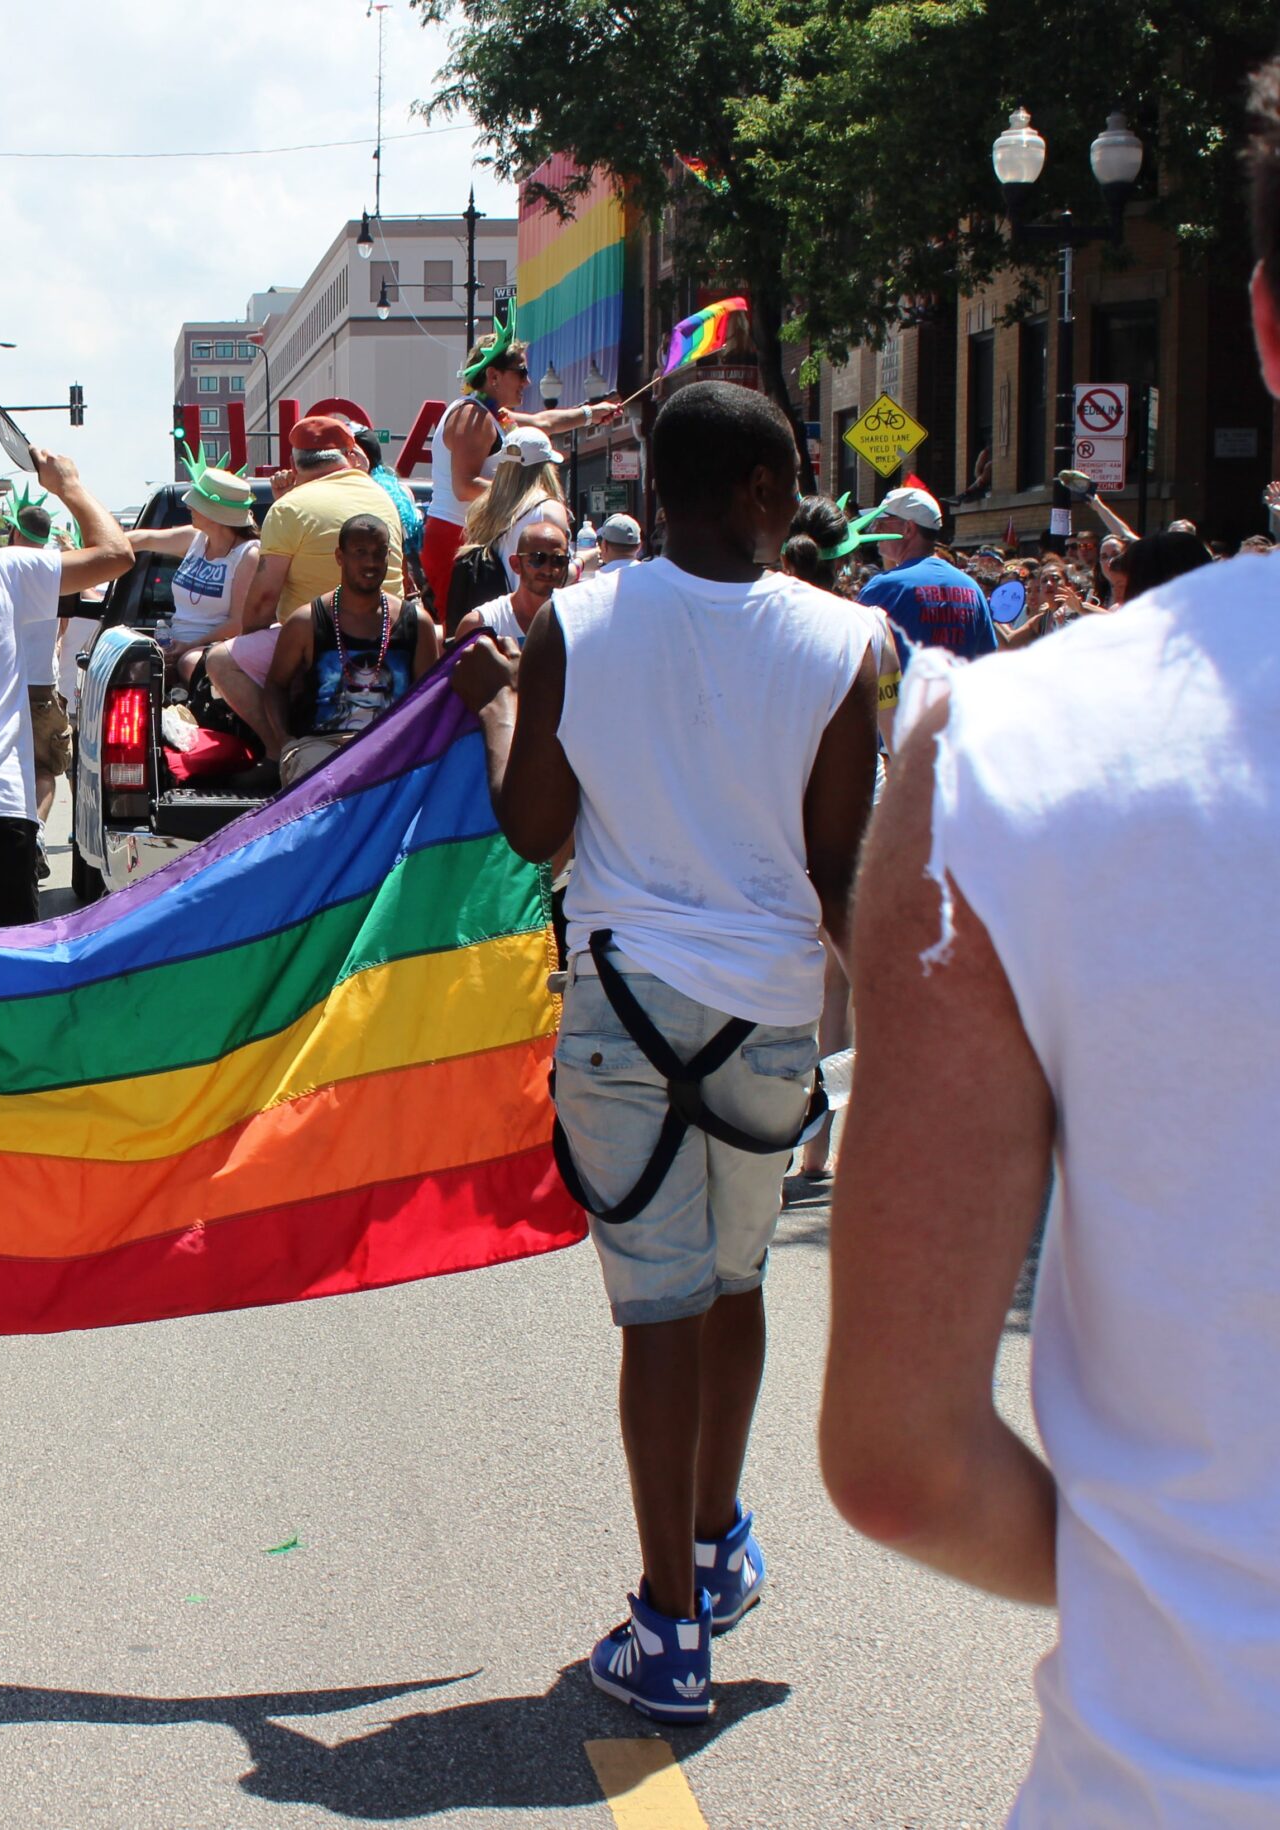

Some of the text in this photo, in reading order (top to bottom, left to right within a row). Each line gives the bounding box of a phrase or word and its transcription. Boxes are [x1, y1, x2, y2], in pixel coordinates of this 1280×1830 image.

[860, 434, 911, 443] SHARED LANE
[869, 445, 890, 453] YIELD
[875, 455, 897, 464] BIKES
[914, 585, 977, 603] STRAIGHT
[921, 606, 975, 624] AGAINST
